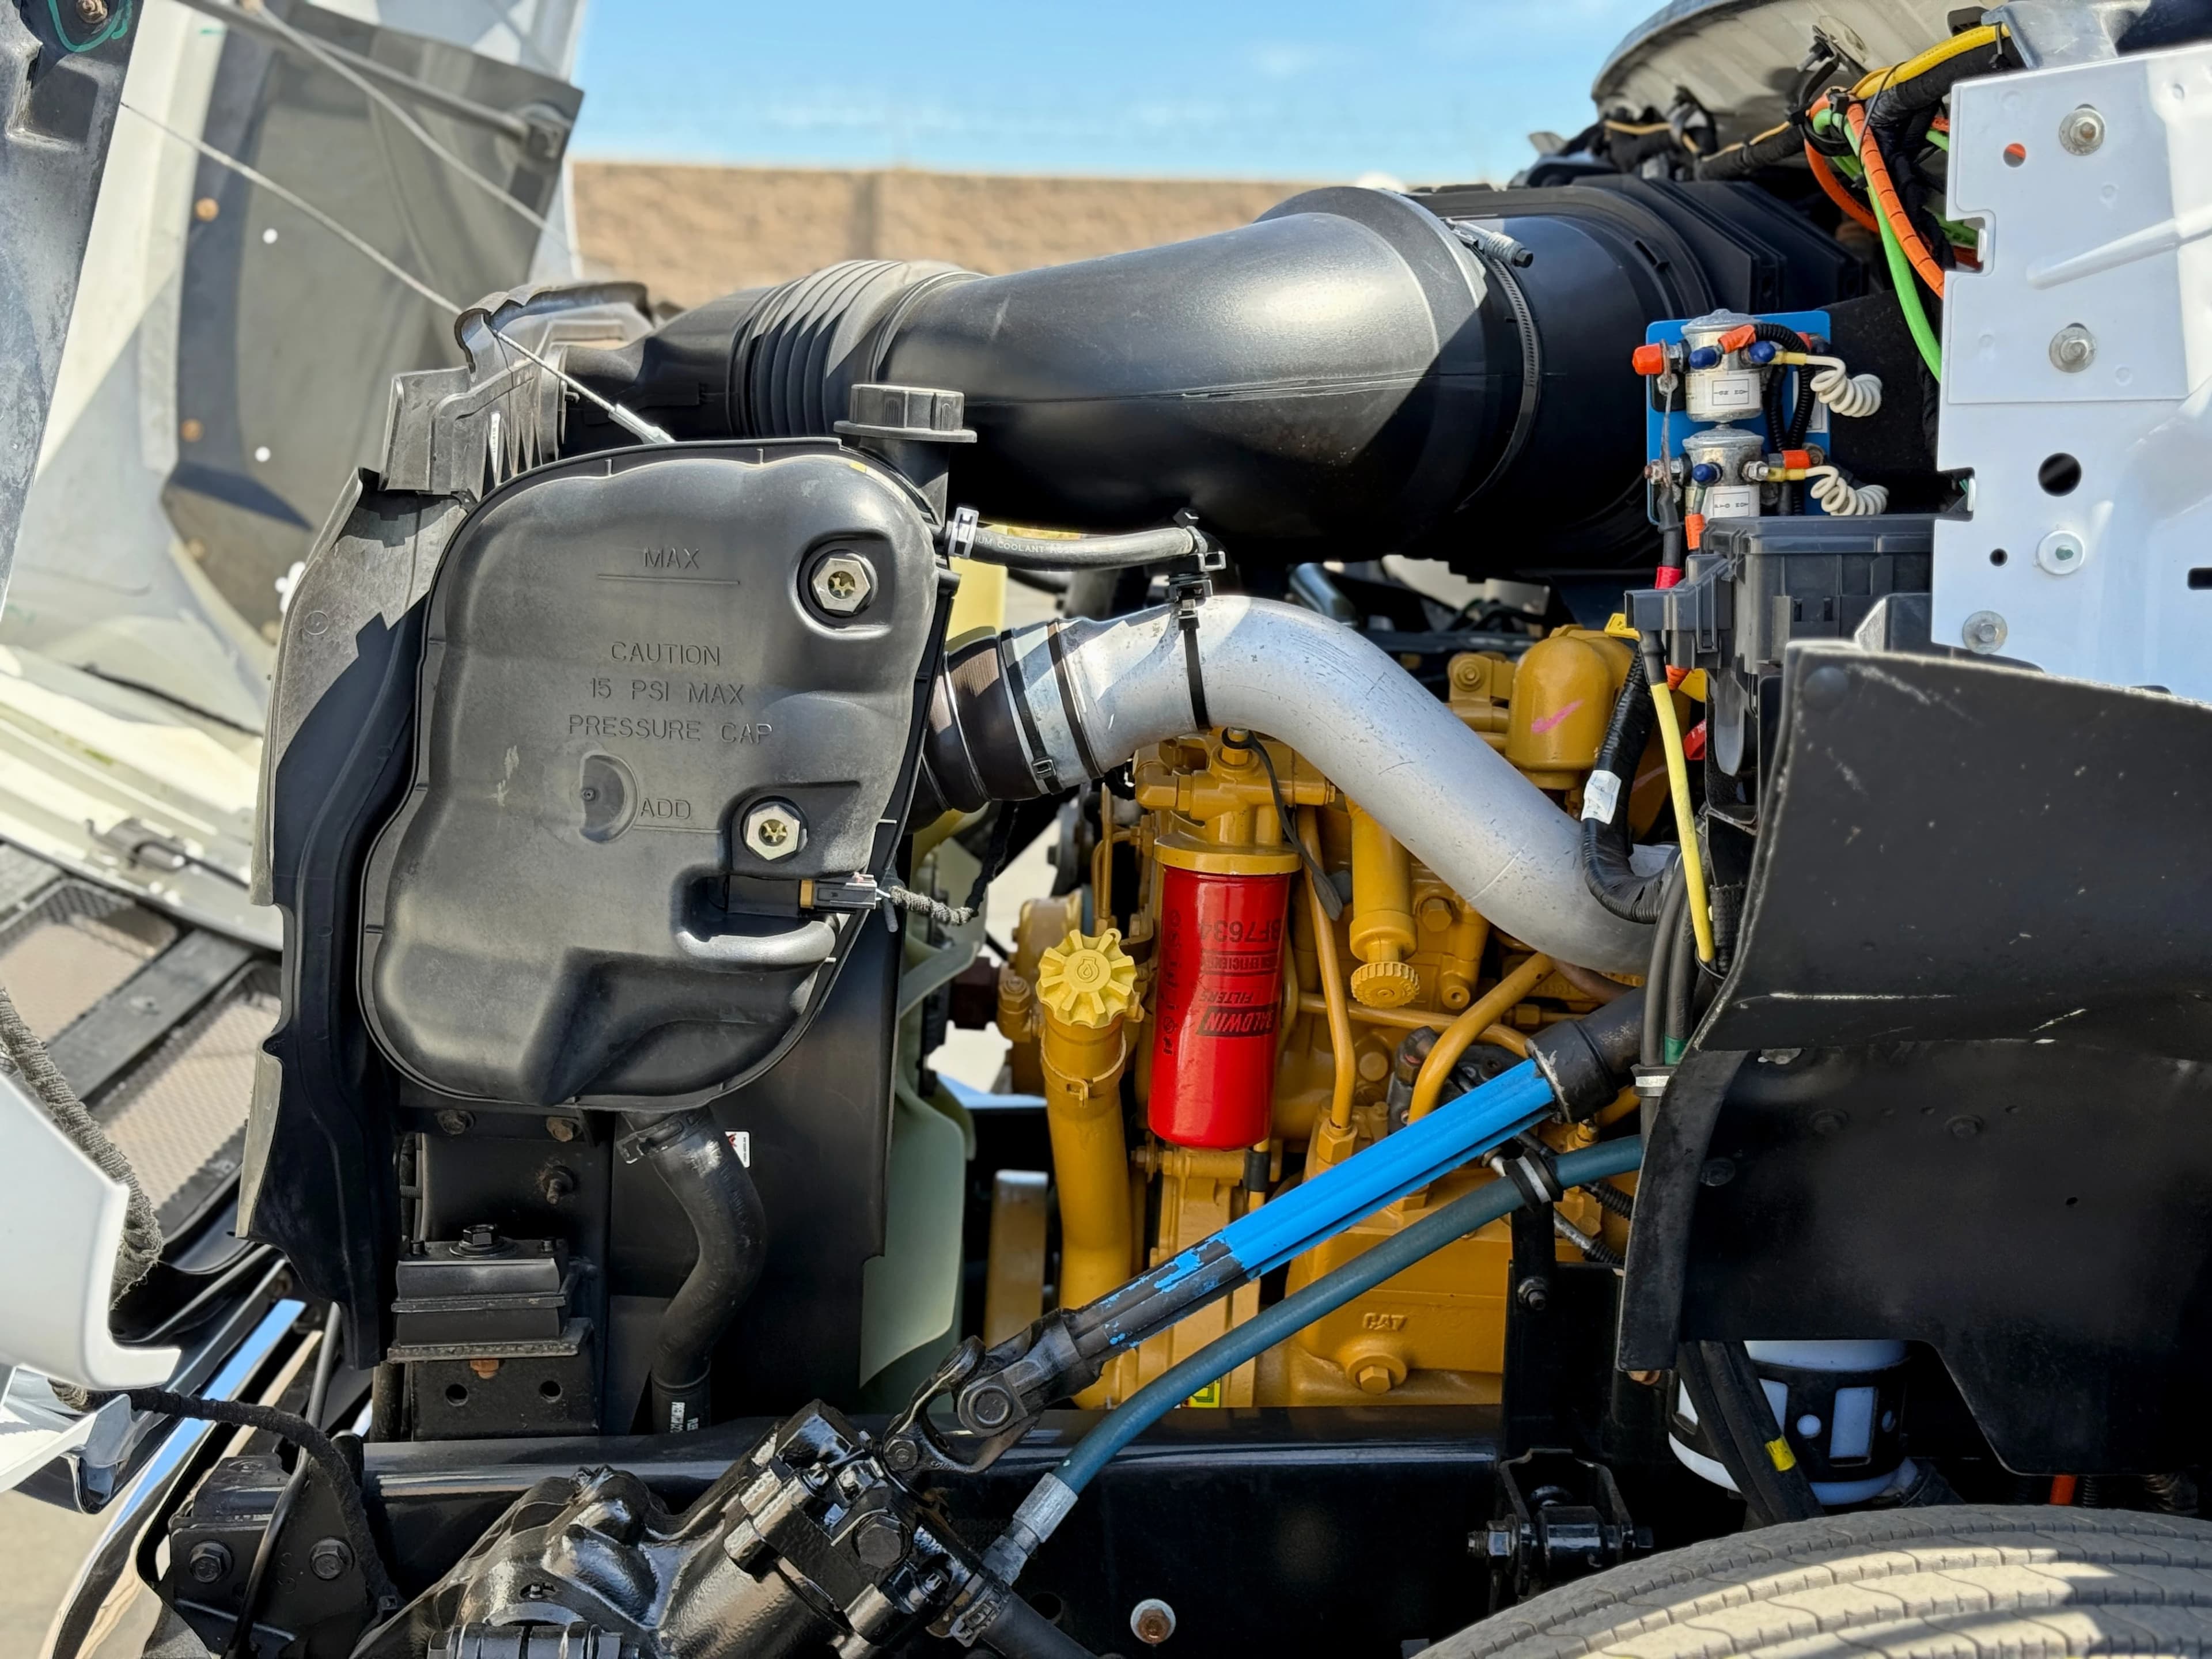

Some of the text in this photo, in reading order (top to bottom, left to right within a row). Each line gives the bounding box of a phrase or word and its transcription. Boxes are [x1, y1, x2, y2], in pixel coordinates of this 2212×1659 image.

[997, 540, 1046, 554] COOLANT
[643, 548, 700, 569] MAX
[611, 641, 721, 666] CAUTION
[590, 677, 744, 706] 15 PSI MAX
[568, 714, 773, 745] PRESSURE CAP
[640, 797, 691, 819] ADD
[1201, 957, 1260, 970] EFFICIEN
[1199, 991, 1255, 1004] FILTERS
[1204, 1011, 1272, 1033] BALDWIN
[1363, 1312, 1408, 1332] CAT
